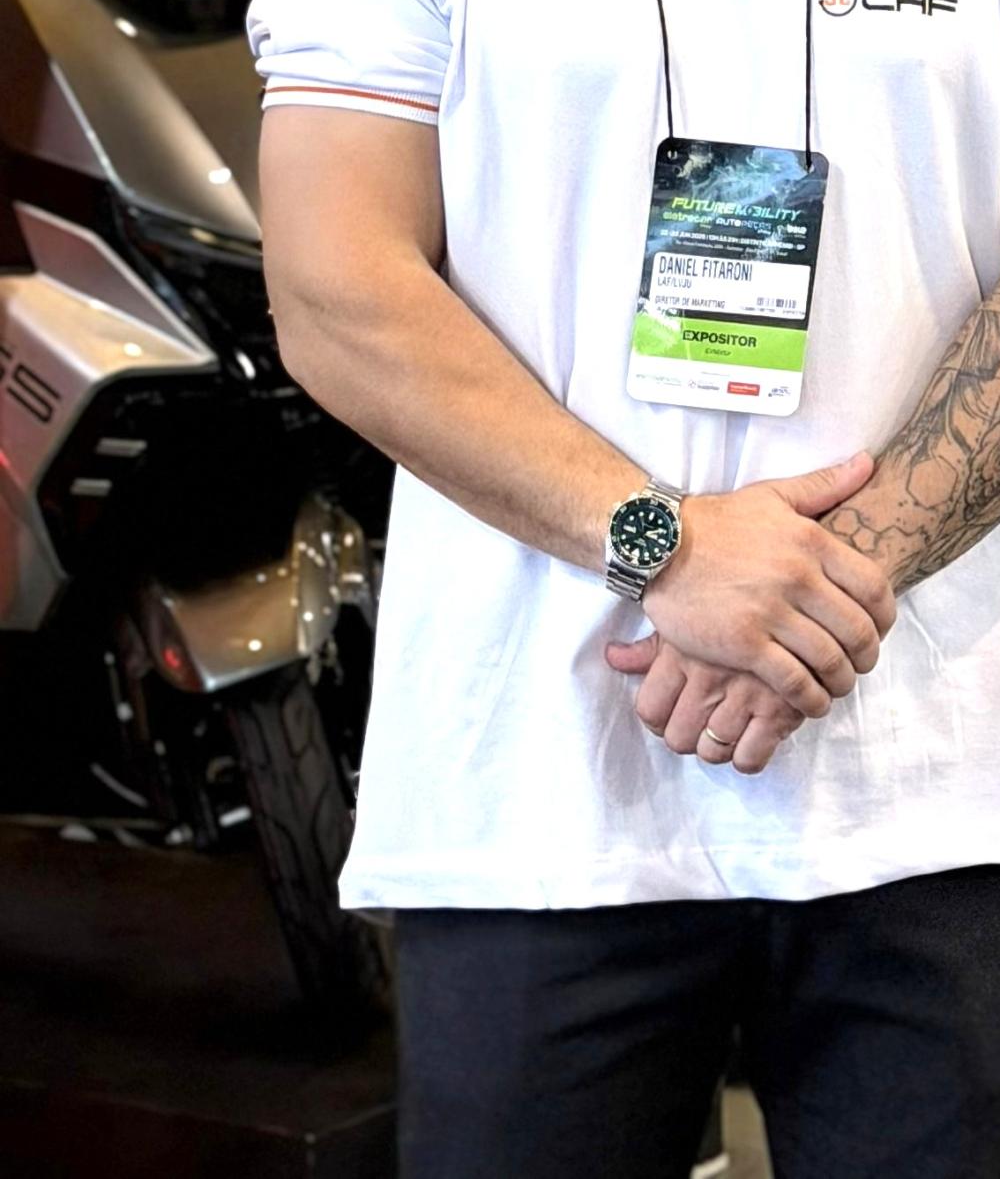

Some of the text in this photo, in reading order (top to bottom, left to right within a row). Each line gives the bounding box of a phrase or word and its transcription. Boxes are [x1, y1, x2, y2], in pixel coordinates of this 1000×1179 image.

[658, 256, 753, 282] DANIEL FITARONI
[682, 329, 758, 348] EXPOSITOR
